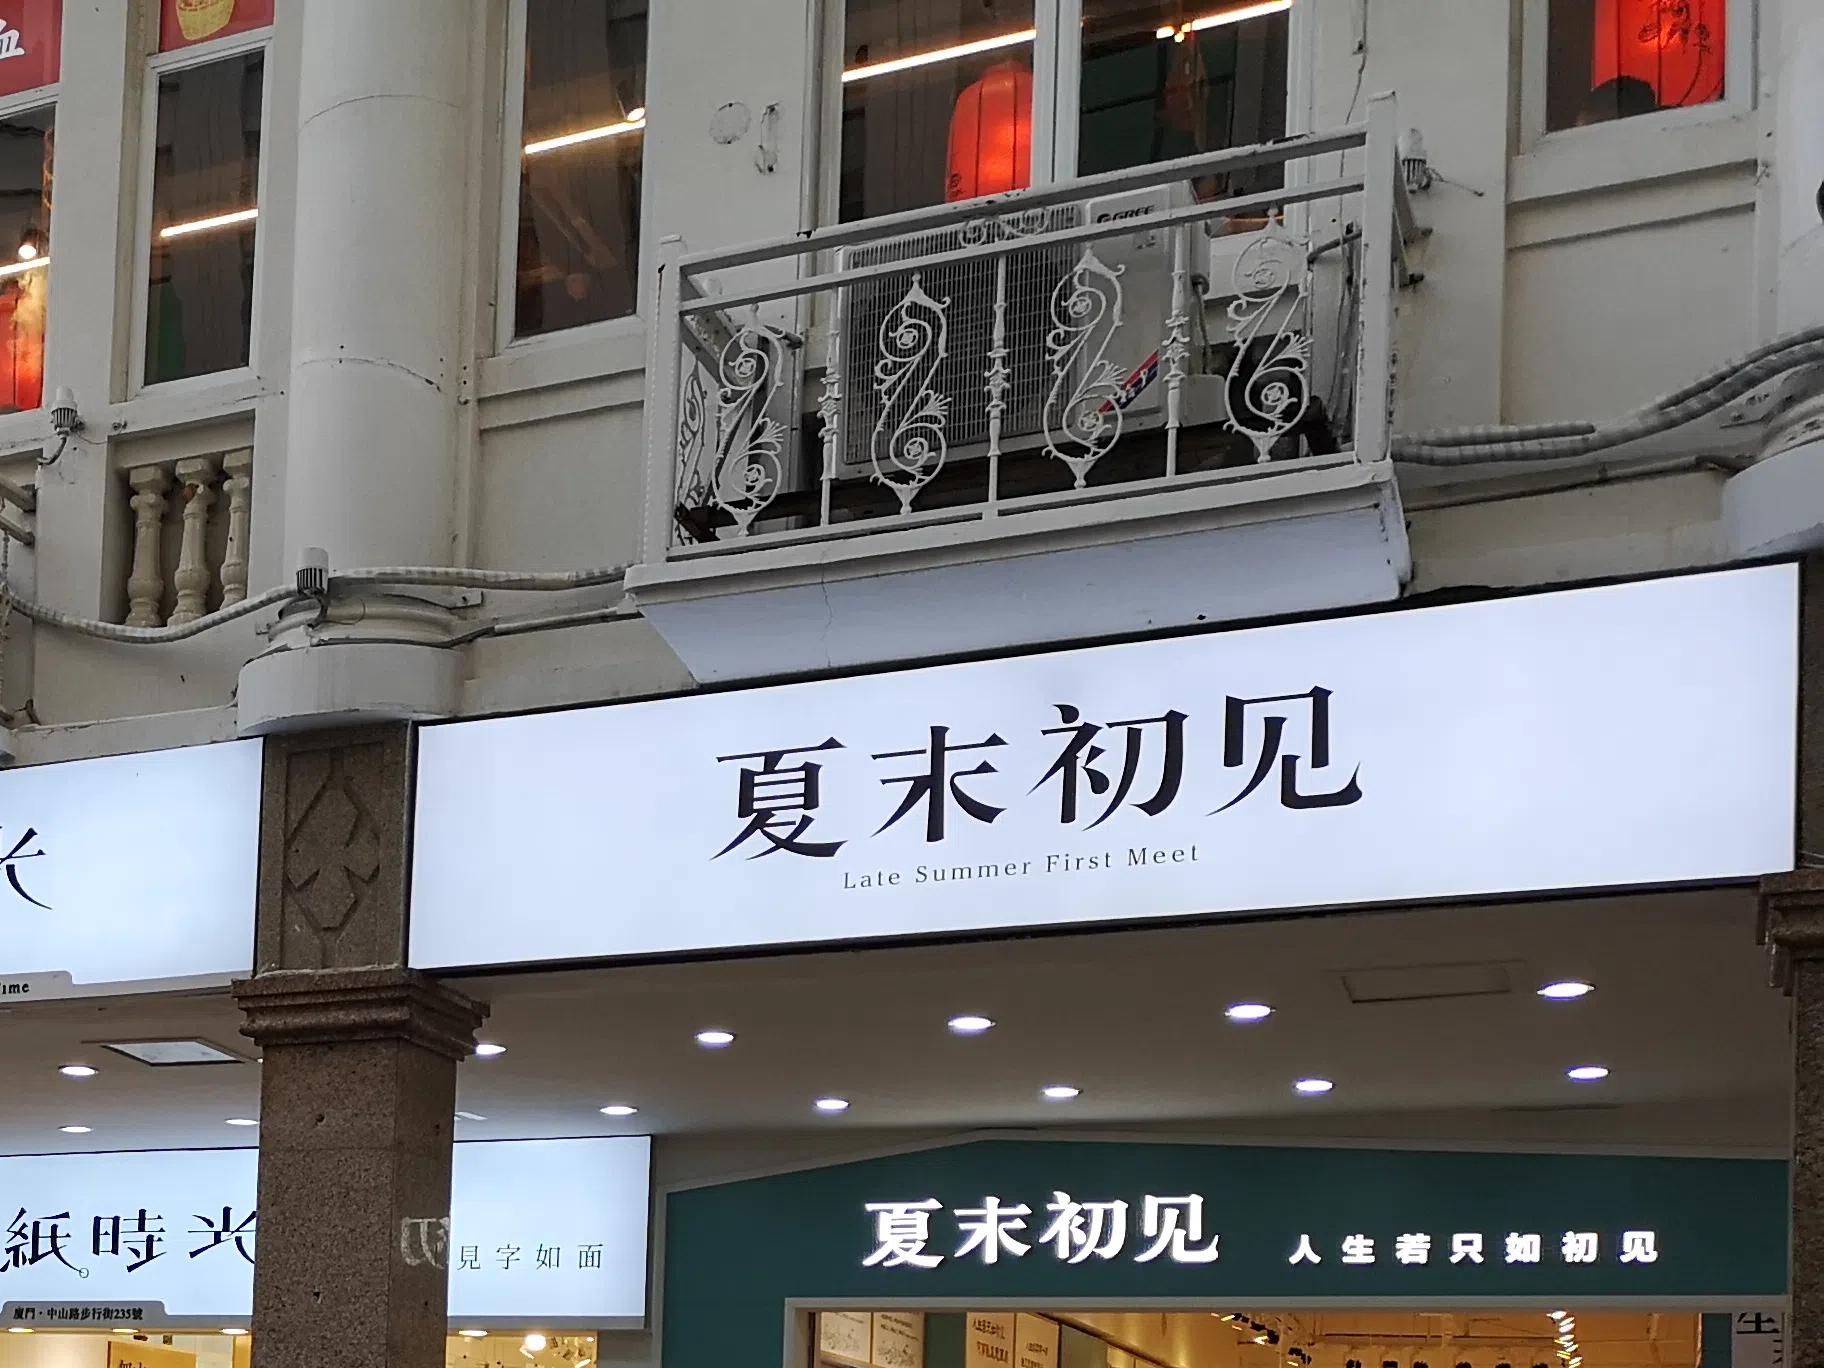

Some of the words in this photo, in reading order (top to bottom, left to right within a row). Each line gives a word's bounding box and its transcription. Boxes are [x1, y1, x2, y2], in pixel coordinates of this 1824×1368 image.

[710, 685, 1362, 861] 夏末初见
[843, 868, 902, 890] Late
[916, 859, 1032, 883] Summer
[1046, 851, 1112, 872] First
[1127, 845, 1199, 866] Meet
[862, 1191, 1219, 1268] 夏末初见
[1288, 1230, 1658, 1265] 人生若只如初见
[457, 1243, 605, 1270] 見字如面
